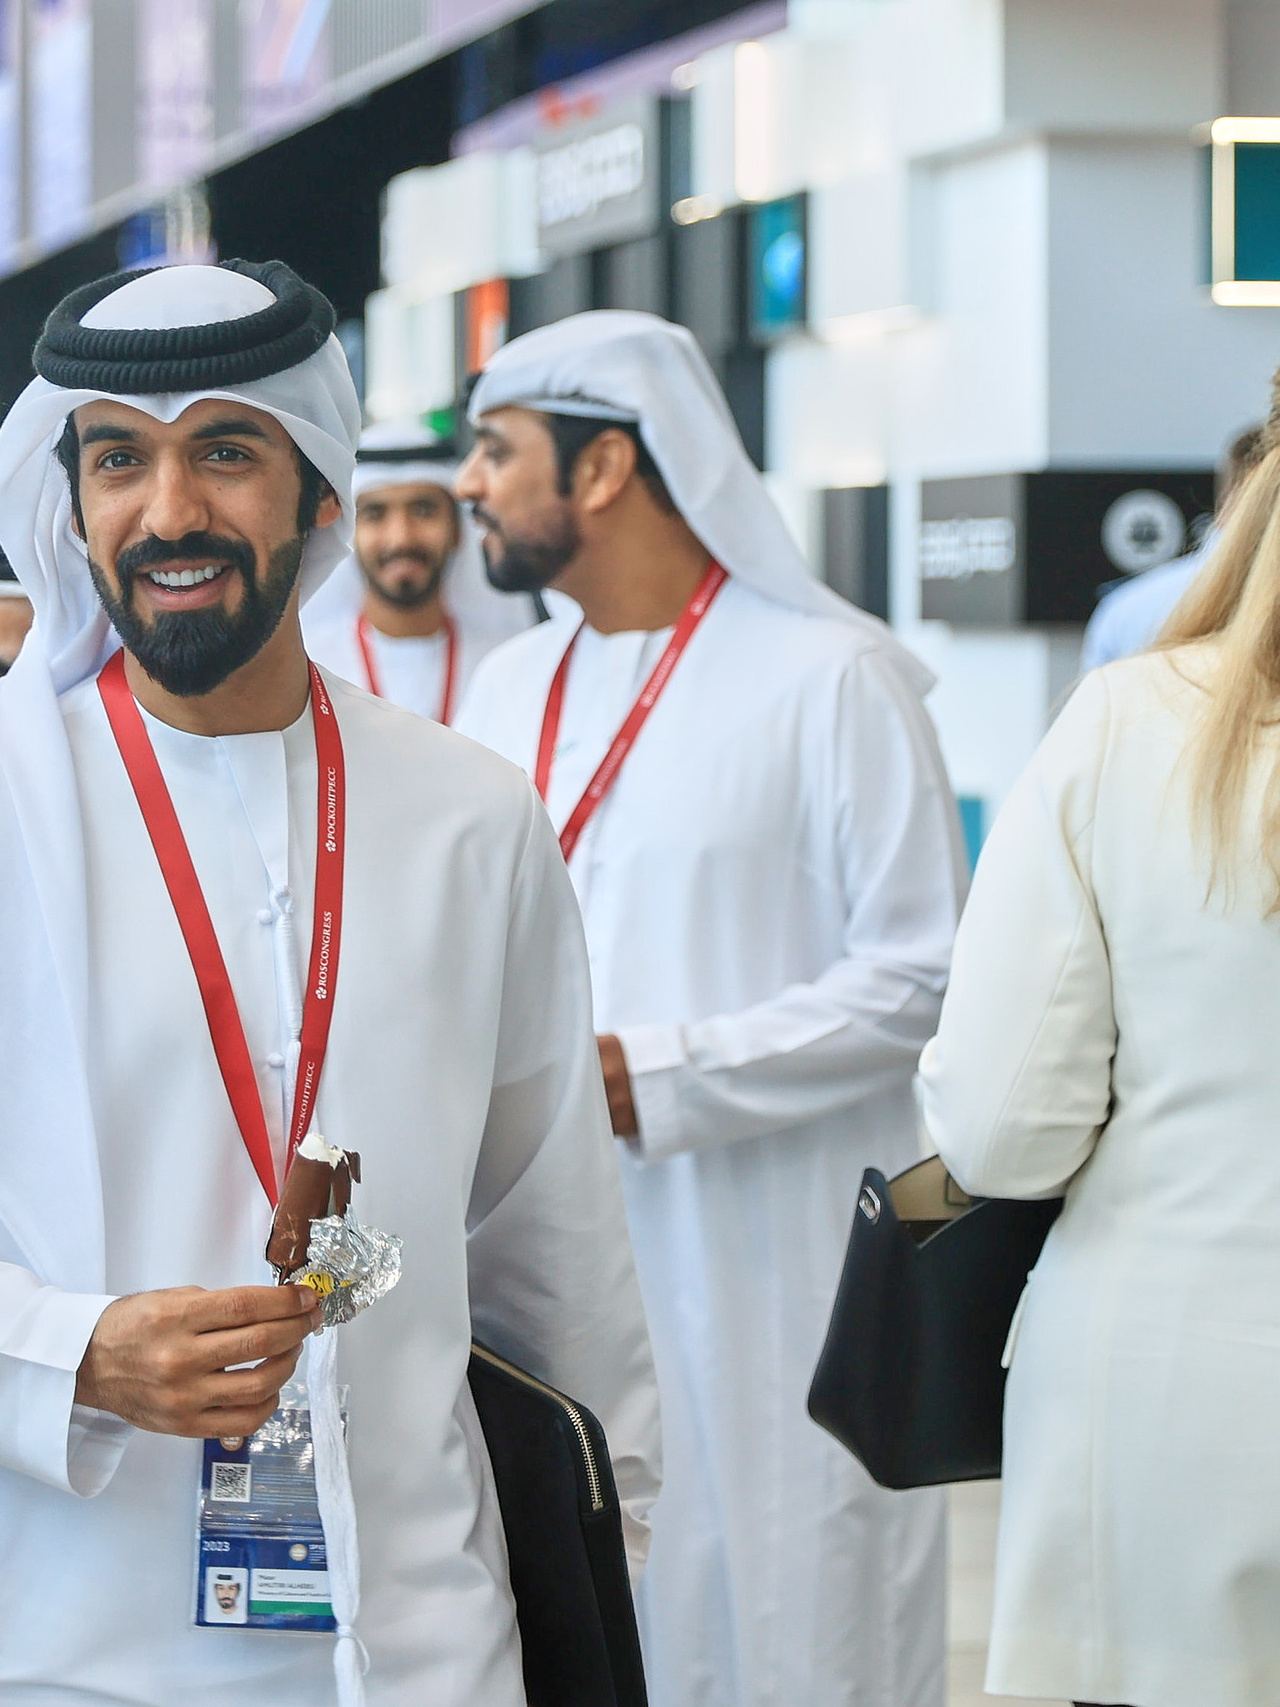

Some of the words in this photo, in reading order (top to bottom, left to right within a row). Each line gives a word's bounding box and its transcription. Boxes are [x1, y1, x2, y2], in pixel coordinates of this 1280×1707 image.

[327, 766, 336, 840] РОСКОНГРЕСС
[318, 910, 332, 987] ROSCONGRESS
[296, 1061, 315, 1140] РОСКОНГРЕСС
[202, 1540, 230, 1552] 2023
